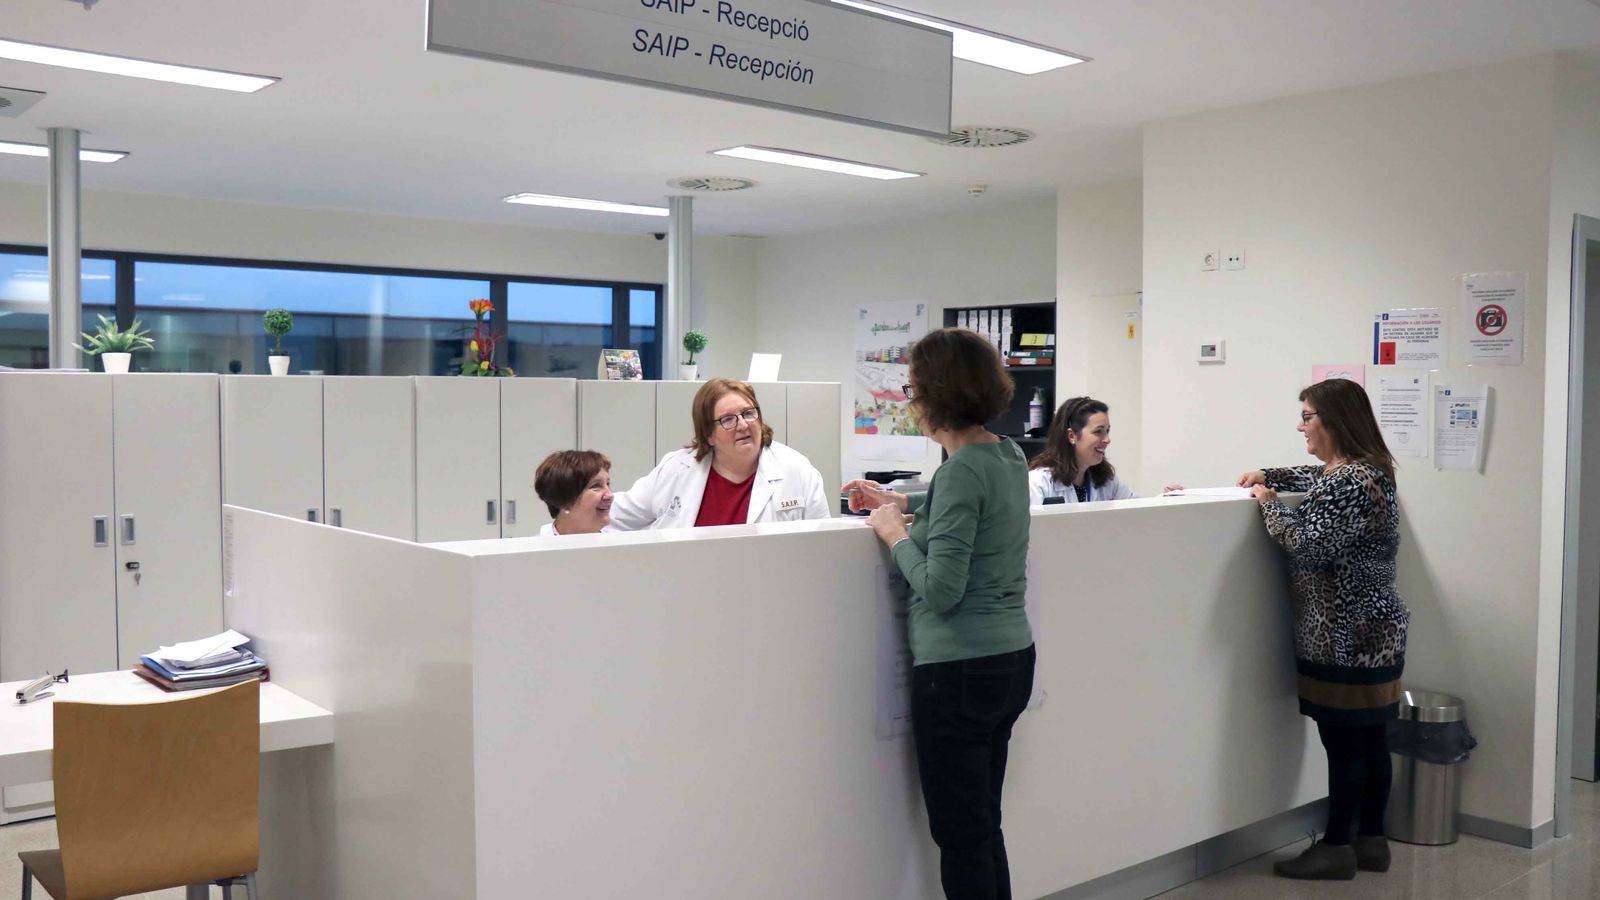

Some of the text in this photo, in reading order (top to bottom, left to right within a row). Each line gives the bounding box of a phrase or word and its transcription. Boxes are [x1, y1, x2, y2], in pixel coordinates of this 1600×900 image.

[717, 1, 809, 41] Recepció
[632, 29, 690, 58] SAIP
[709, 44, 814, 85] Recepción
[780, 499, 799, 508] S.A.I.P.
